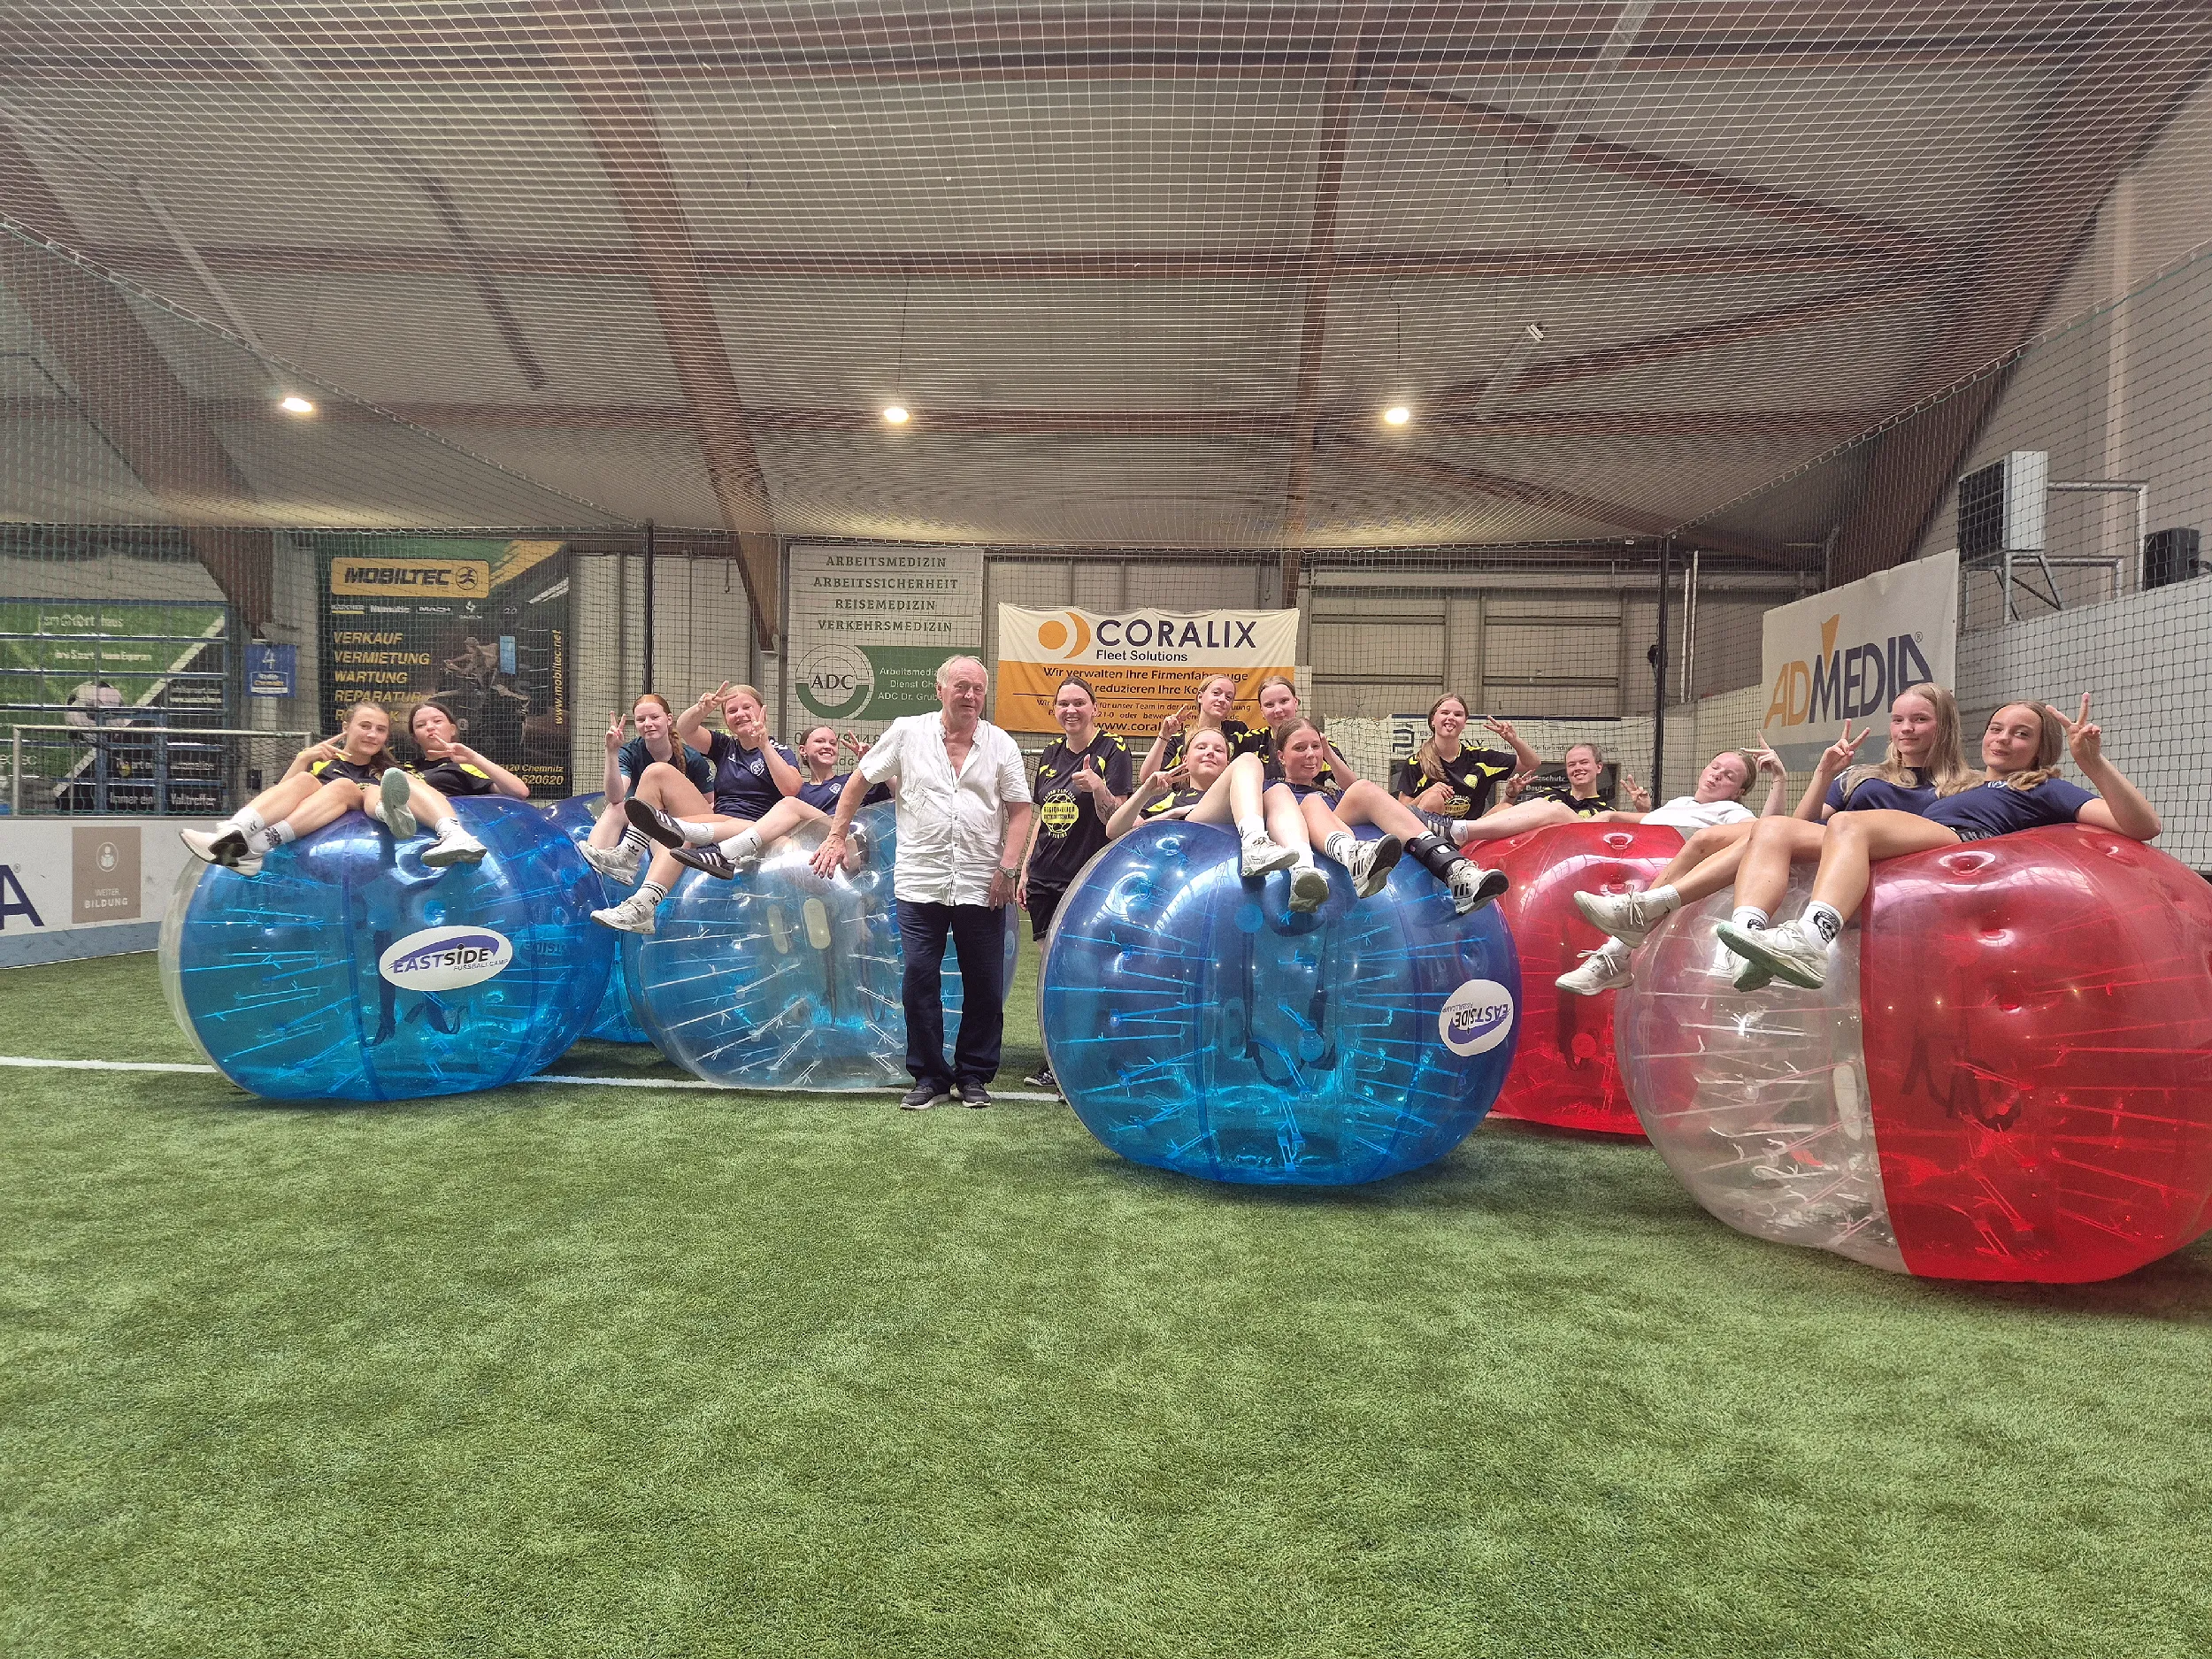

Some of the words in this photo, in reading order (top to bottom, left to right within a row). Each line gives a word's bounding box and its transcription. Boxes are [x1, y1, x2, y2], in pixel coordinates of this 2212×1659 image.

[826, 556, 947, 567] ARBEITSMEDIZIN
[344, 567, 452, 586] MOBILTEC
[813, 577, 958, 589] ARBEITSSICHERHEIT
[835, 598, 936, 611] REISEMEDIZIN
[818, 620, 953, 633] VERKEHRSMEDIZIN
[333, 632, 403, 646] VERKAUF
[1096, 618, 1257, 649] CORALIX
[334, 652, 431, 665] VERMIETUNG
[1096, 649, 1126, 661] Fleet
[1130, 650, 1188, 662] Solutions
[334, 672, 408, 684] WARTUNG
[552, 629, 563, 726] www.mobiltec.net
[879, 667, 939, 676] Arbeitsmediz
[1043, 666, 1064, 677] Wir
[1066, 669, 1123, 679] verwalten
[1126, 669, 1148, 680] Ihre
[810, 674, 854, 690] ADC
[890, 680, 918, 688] Dienst
[1094, 684, 1156, 695] reduzieren
[1158, 685, 1181, 695] Ihre
[901, 692, 913, 701] Dr.
[521, 764, 565, 772] Chemnitz
[84, 897, 128, 909] BILDUNG
[393, 943, 489, 974] EASTSIDE
[1454, 1003, 1509, 1033] EASTSIDE
